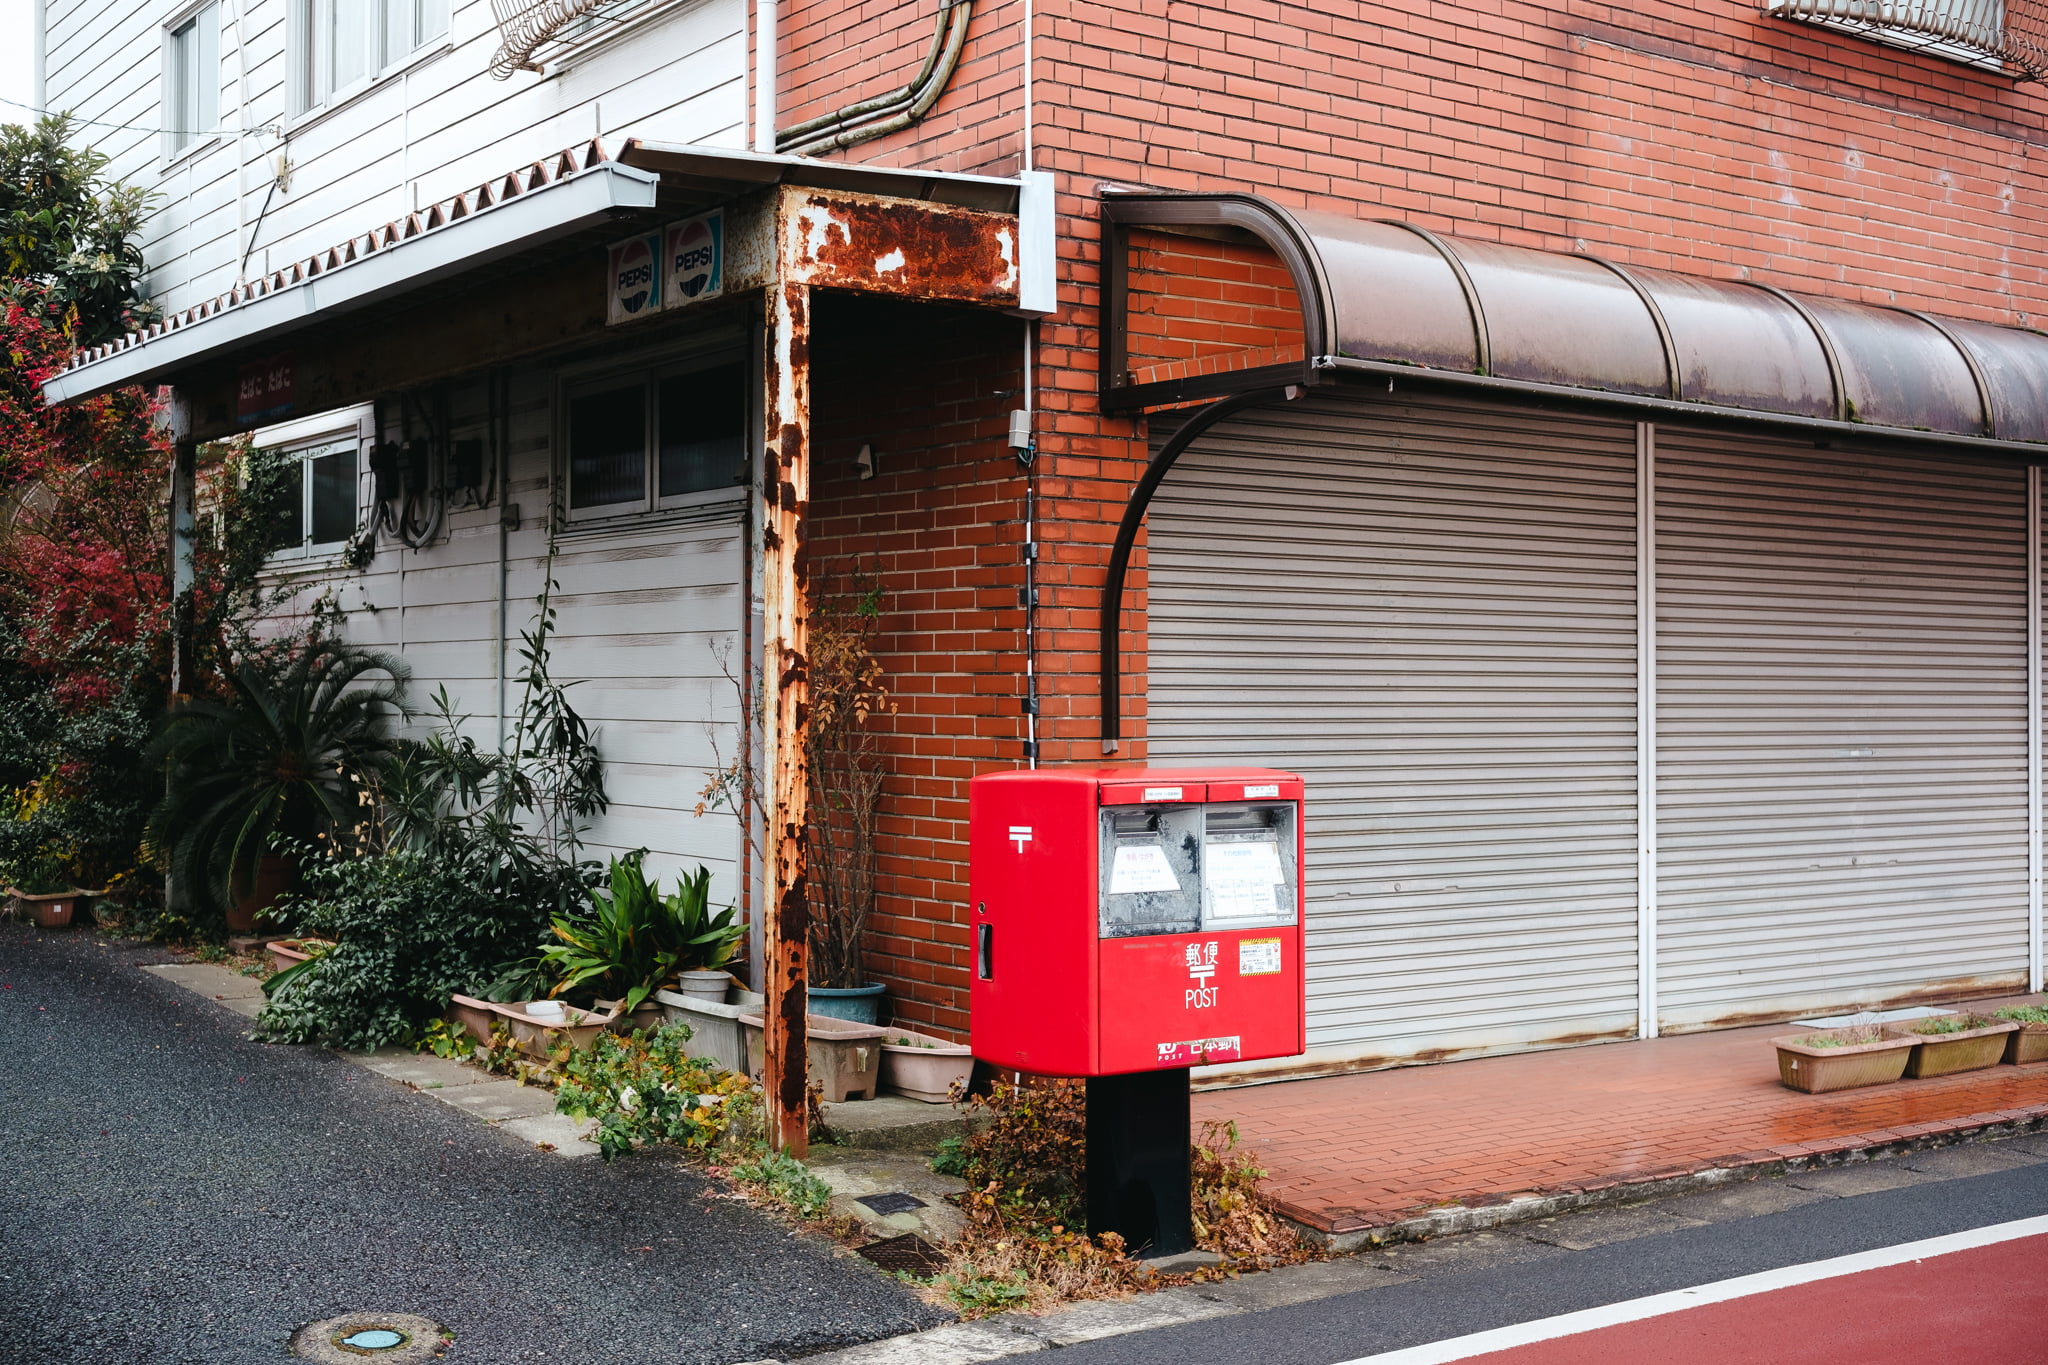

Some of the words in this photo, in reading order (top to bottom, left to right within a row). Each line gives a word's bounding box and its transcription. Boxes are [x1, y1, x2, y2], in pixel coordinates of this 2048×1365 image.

[675, 245, 713, 273] PEPSI
[618, 264, 652, 290] PEPSI
[240, 376, 263, 400] たばこ
[268, 366, 291, 392] たばこ
[1185, 941, 1219, 967] 郵便
[1185, 987, 1219, 1010] POST
[1158, 1053, 1183, 1061] POST
